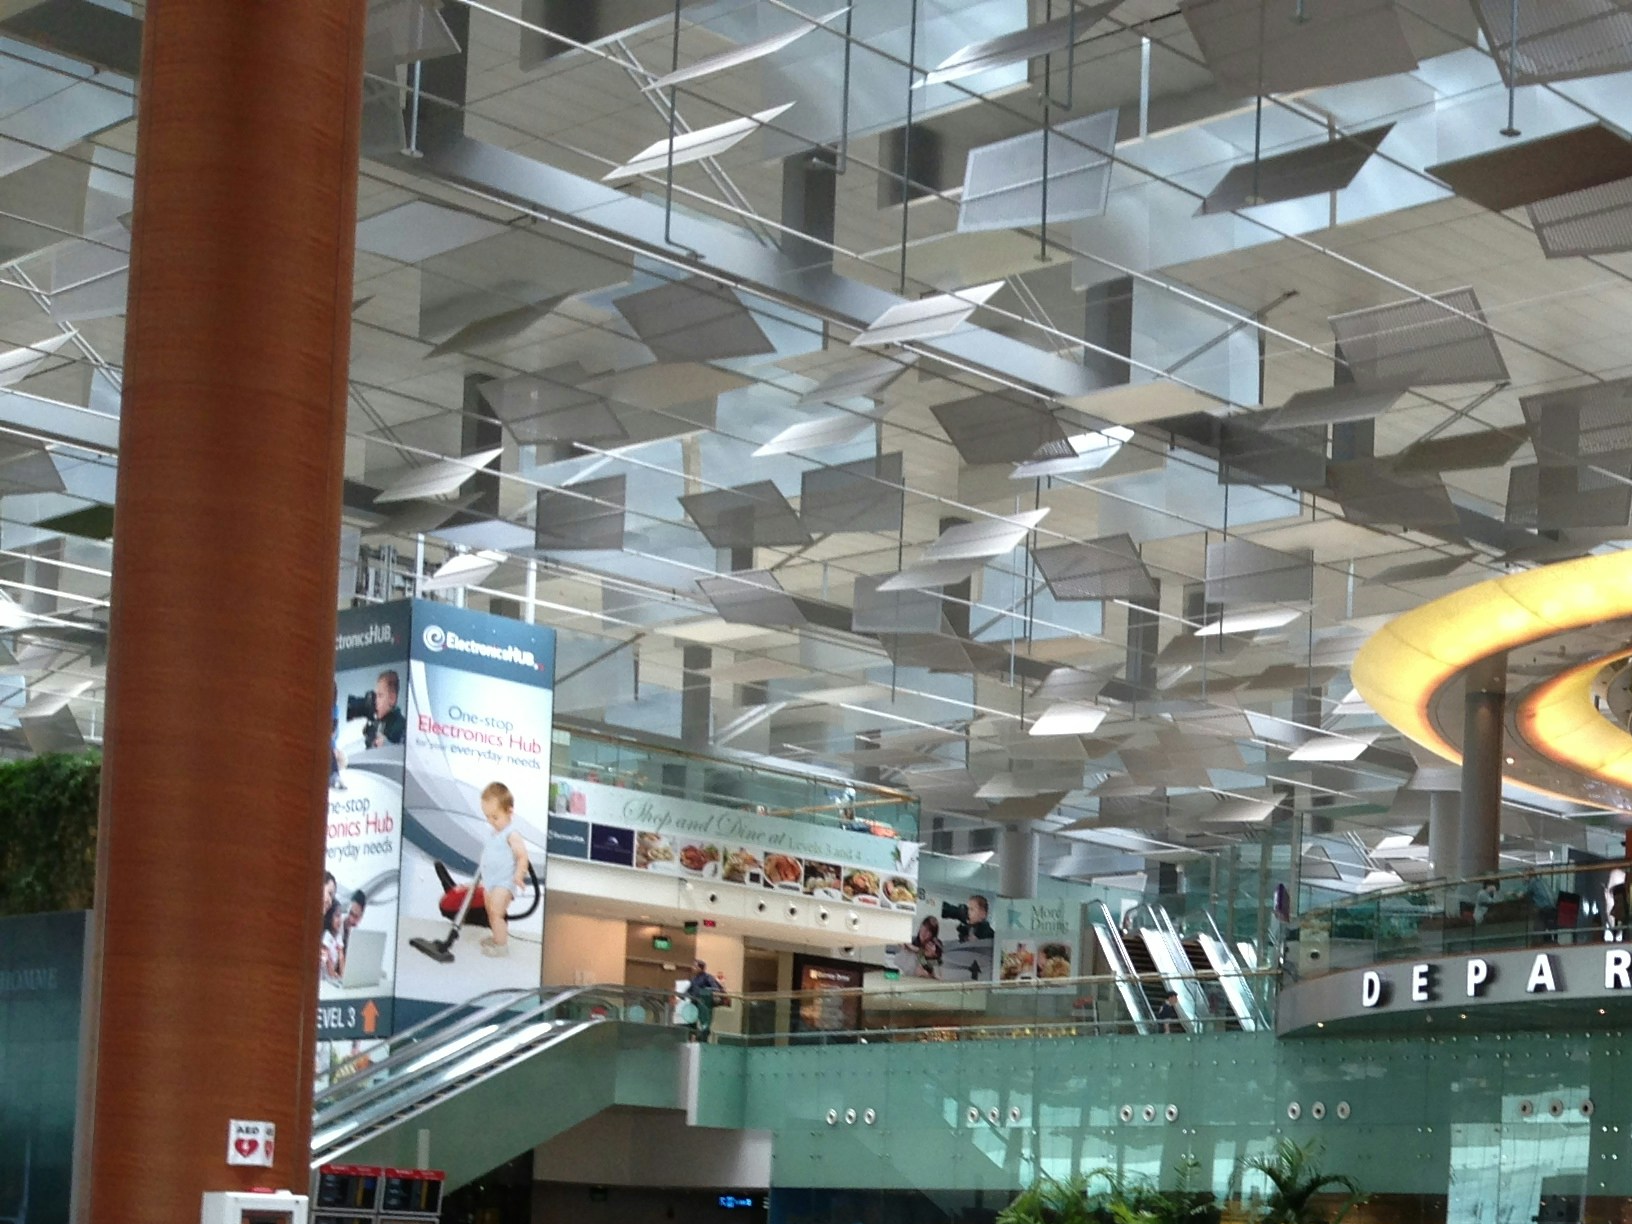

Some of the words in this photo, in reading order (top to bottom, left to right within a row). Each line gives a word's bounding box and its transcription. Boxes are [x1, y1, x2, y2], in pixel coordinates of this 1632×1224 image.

[448, 705, 514, 734] One-stop
[418, 714, 503, 747] Electronics
[509, 734, 542, 754] Hub
[450, 744, 502, 765] everyday
[506, 755, 541, 769] needs
[365, 810, 394, 835] Hub
[622, 800, 672, 832] Shop
[675, 815, 714, 833] and
[716, 811, 766, 842] Dine
[768, 831, 788, 848] at
[363, 836, 393, 856] needs
[1031, 919, 1070, 935] Dining
[347, 1003, 356, 1028] 3
[236, 1126, 260, 1134] AED
